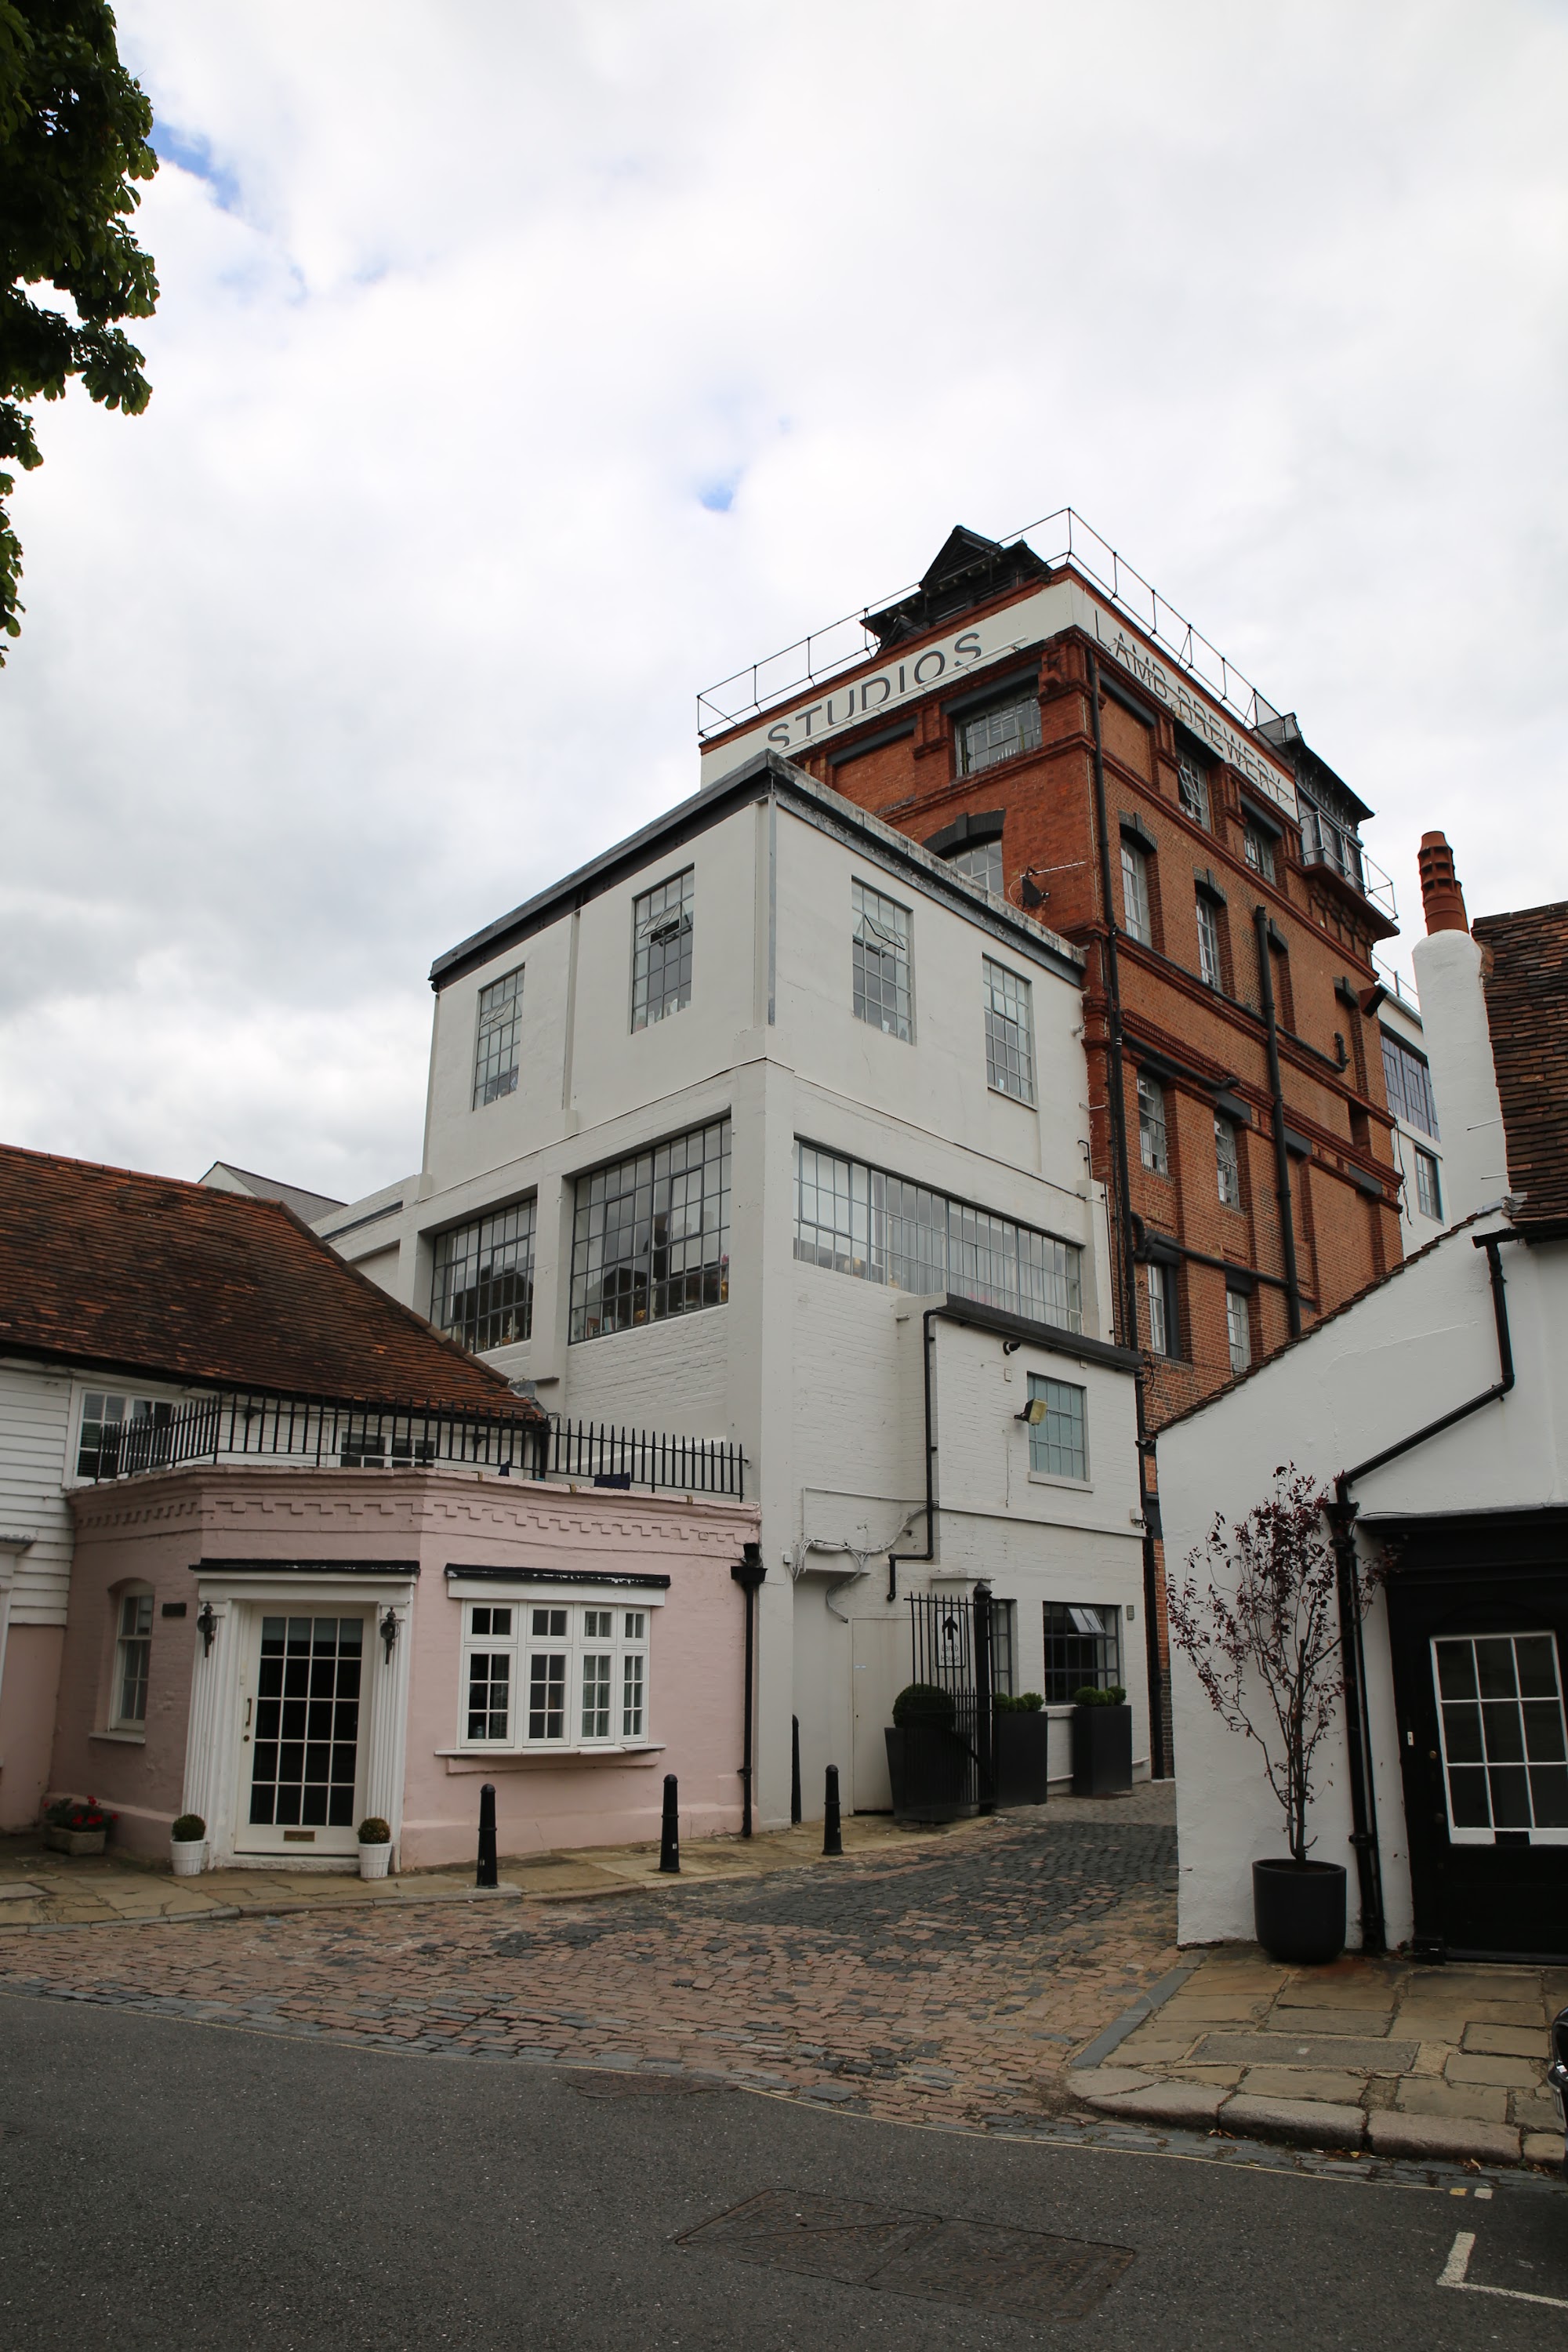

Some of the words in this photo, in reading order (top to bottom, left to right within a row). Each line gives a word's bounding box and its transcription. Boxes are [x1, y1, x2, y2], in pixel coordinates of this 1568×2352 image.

[768, 632, 983, 750] STUDIOS
[1094, 609, 1167, 699] LAMB
[1178, 685, 1281, 801] BREWERY
